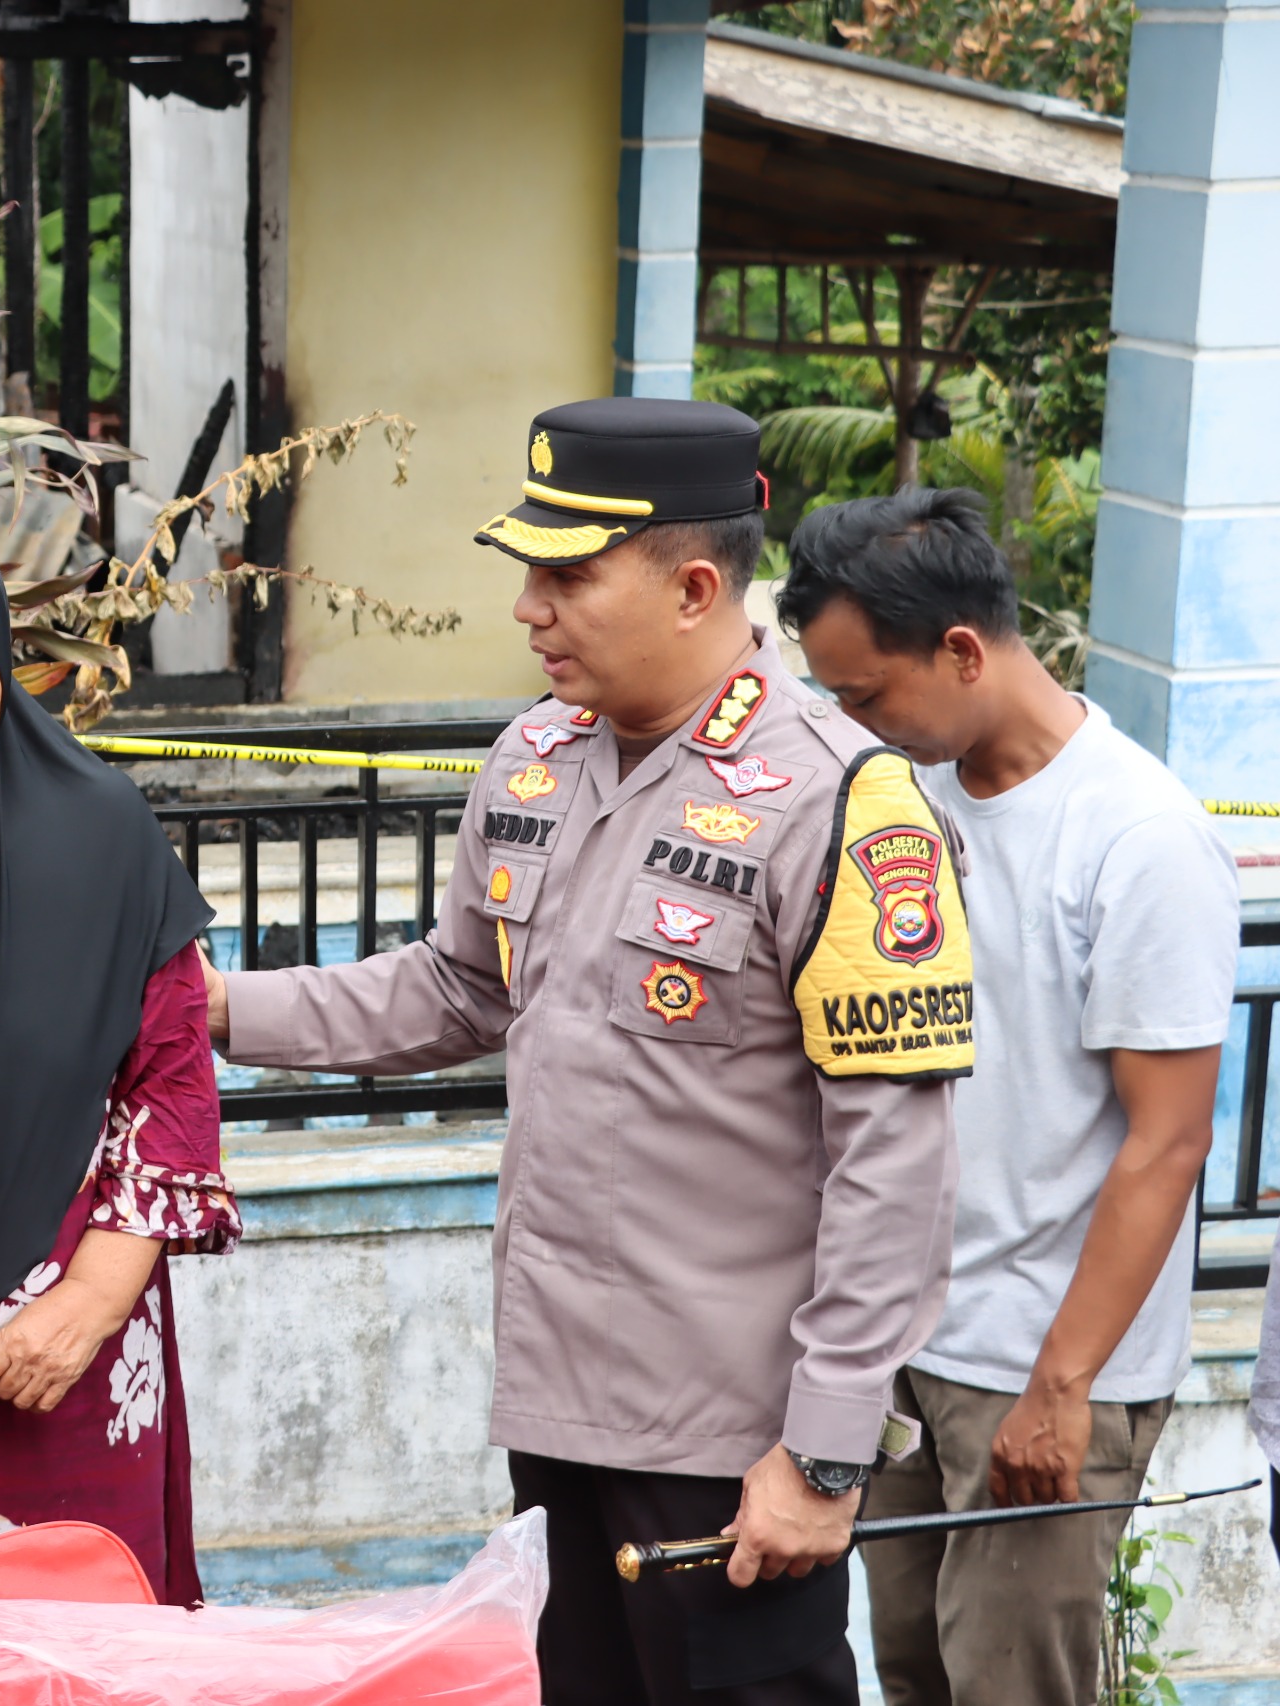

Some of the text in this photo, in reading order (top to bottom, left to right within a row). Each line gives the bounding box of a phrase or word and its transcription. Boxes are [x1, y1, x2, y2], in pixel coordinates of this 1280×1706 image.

[485, 812, 557, 847] DEDDY
[869, 836, 929, 857] POLRESTA
[871, 847, 930, 866] BENGKULU
[643, 838, 759, 896] POLRI
[877, 867, 929, 884] BENGKULU
